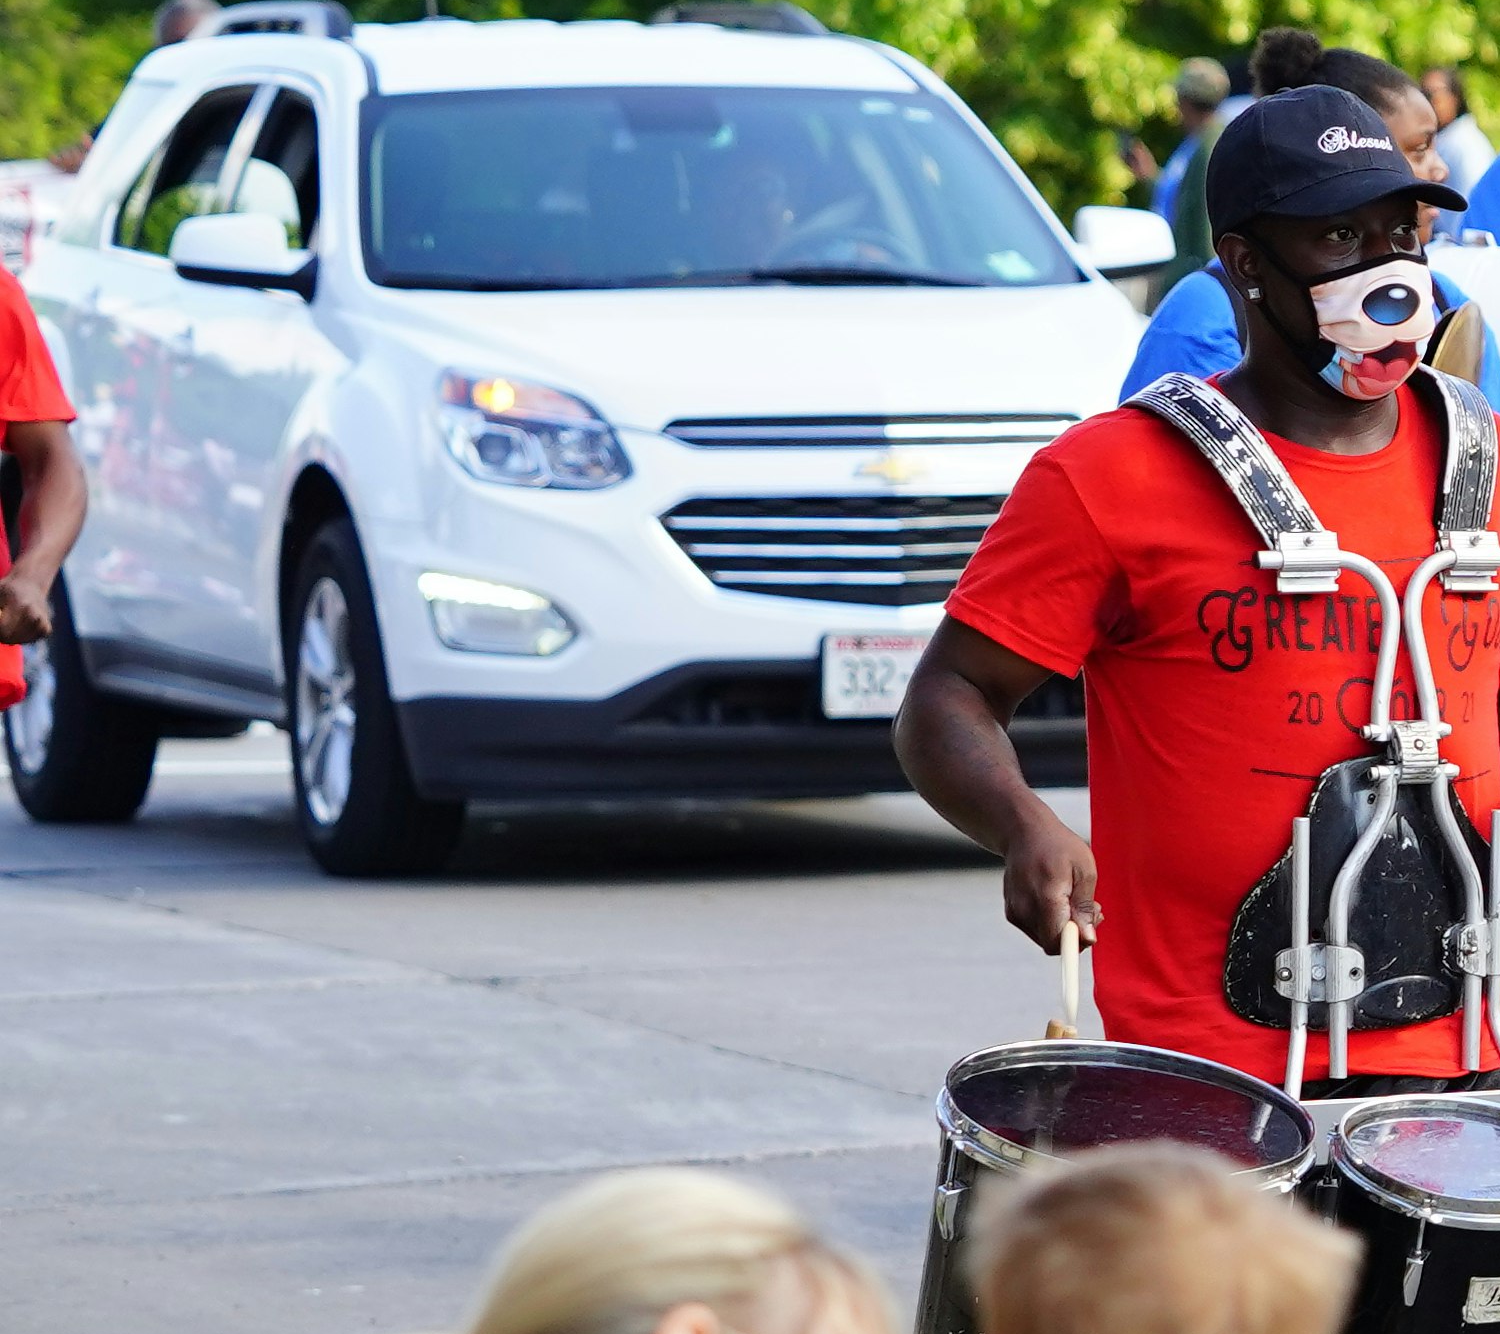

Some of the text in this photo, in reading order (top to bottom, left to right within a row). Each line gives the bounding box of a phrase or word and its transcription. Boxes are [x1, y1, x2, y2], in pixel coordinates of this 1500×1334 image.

[1318, 126, 1393, 154] Blessed
[1197, 586, 1386, 672] GREATE
[1286, 690, 1324, 725] 20
[1460, 690, 1476, 723] 21
